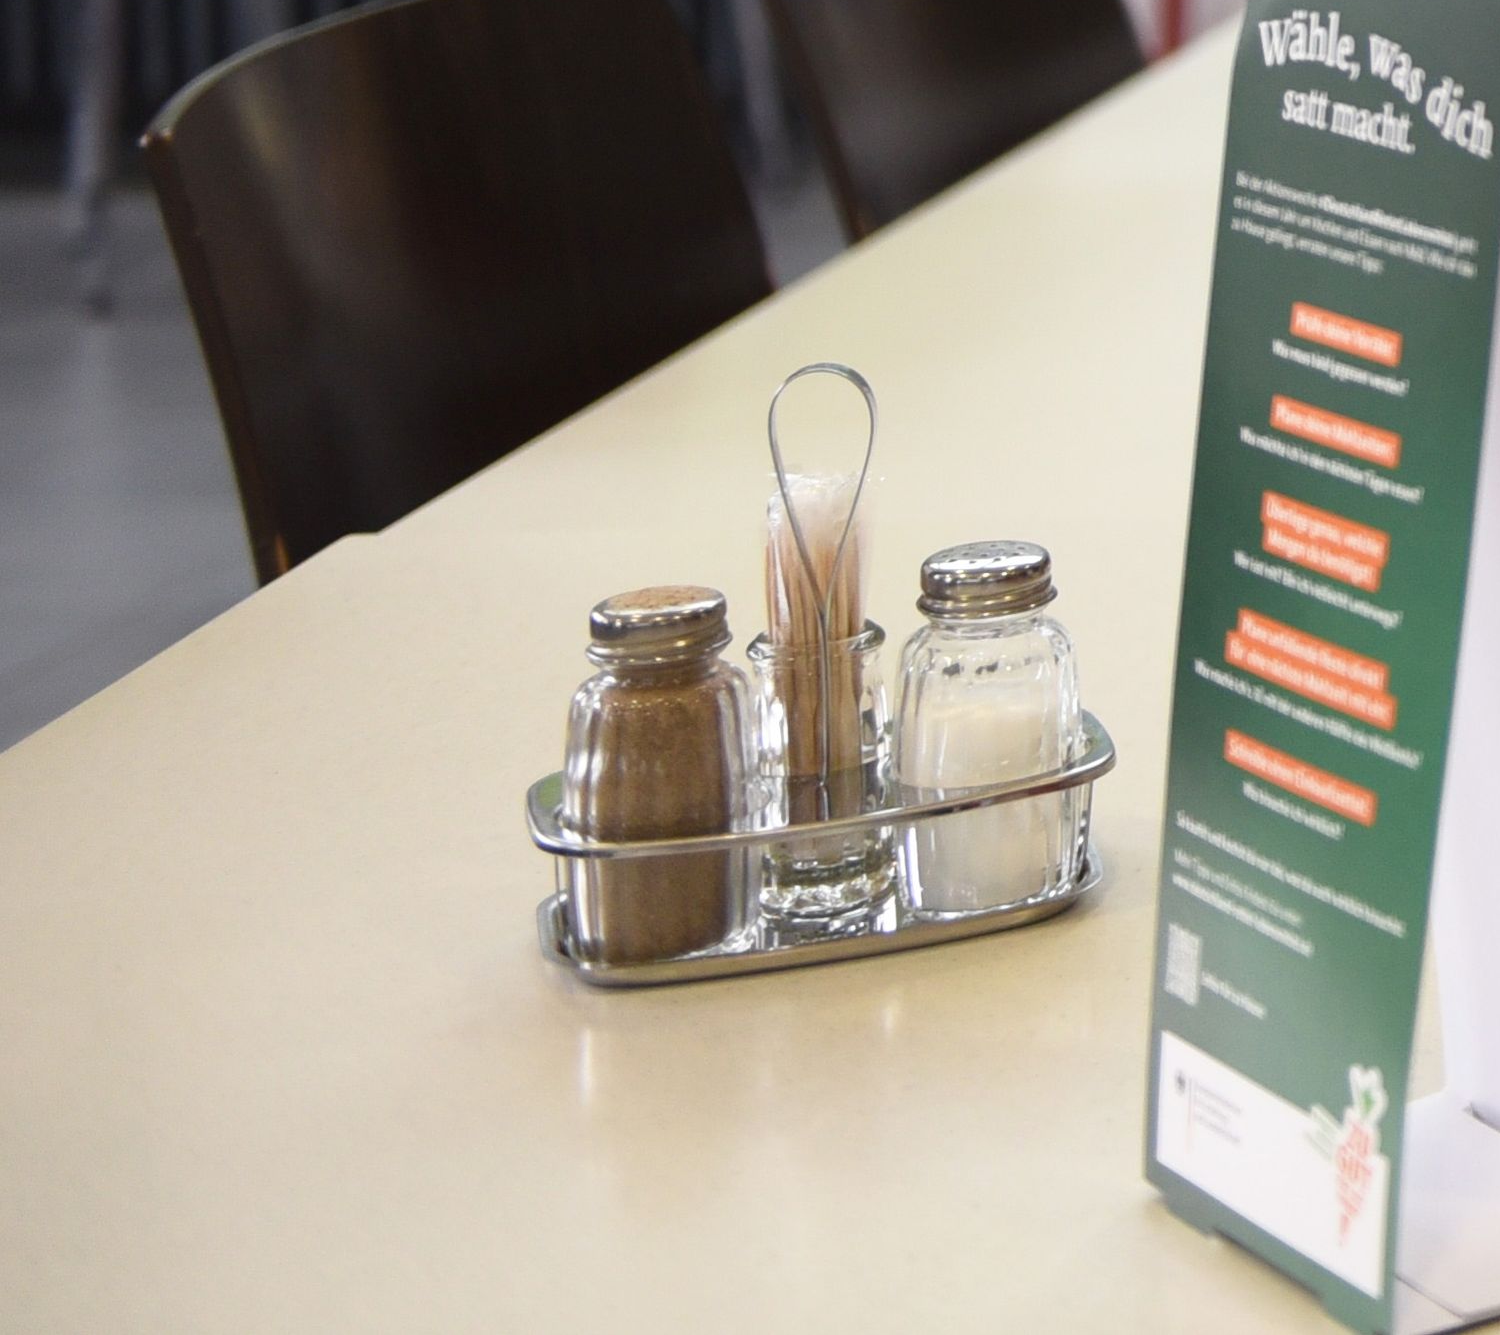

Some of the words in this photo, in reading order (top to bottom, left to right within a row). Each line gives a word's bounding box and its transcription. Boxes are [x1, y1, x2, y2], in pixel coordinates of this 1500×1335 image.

[1258, 9, 1361, 80] Wähle,
[1369, 33, 1426, 104] was
[1425, 75, 1494, 160] dich
[1281, 89, 1330, 130] satt
[1330, 101, 1416, 155] macht.
